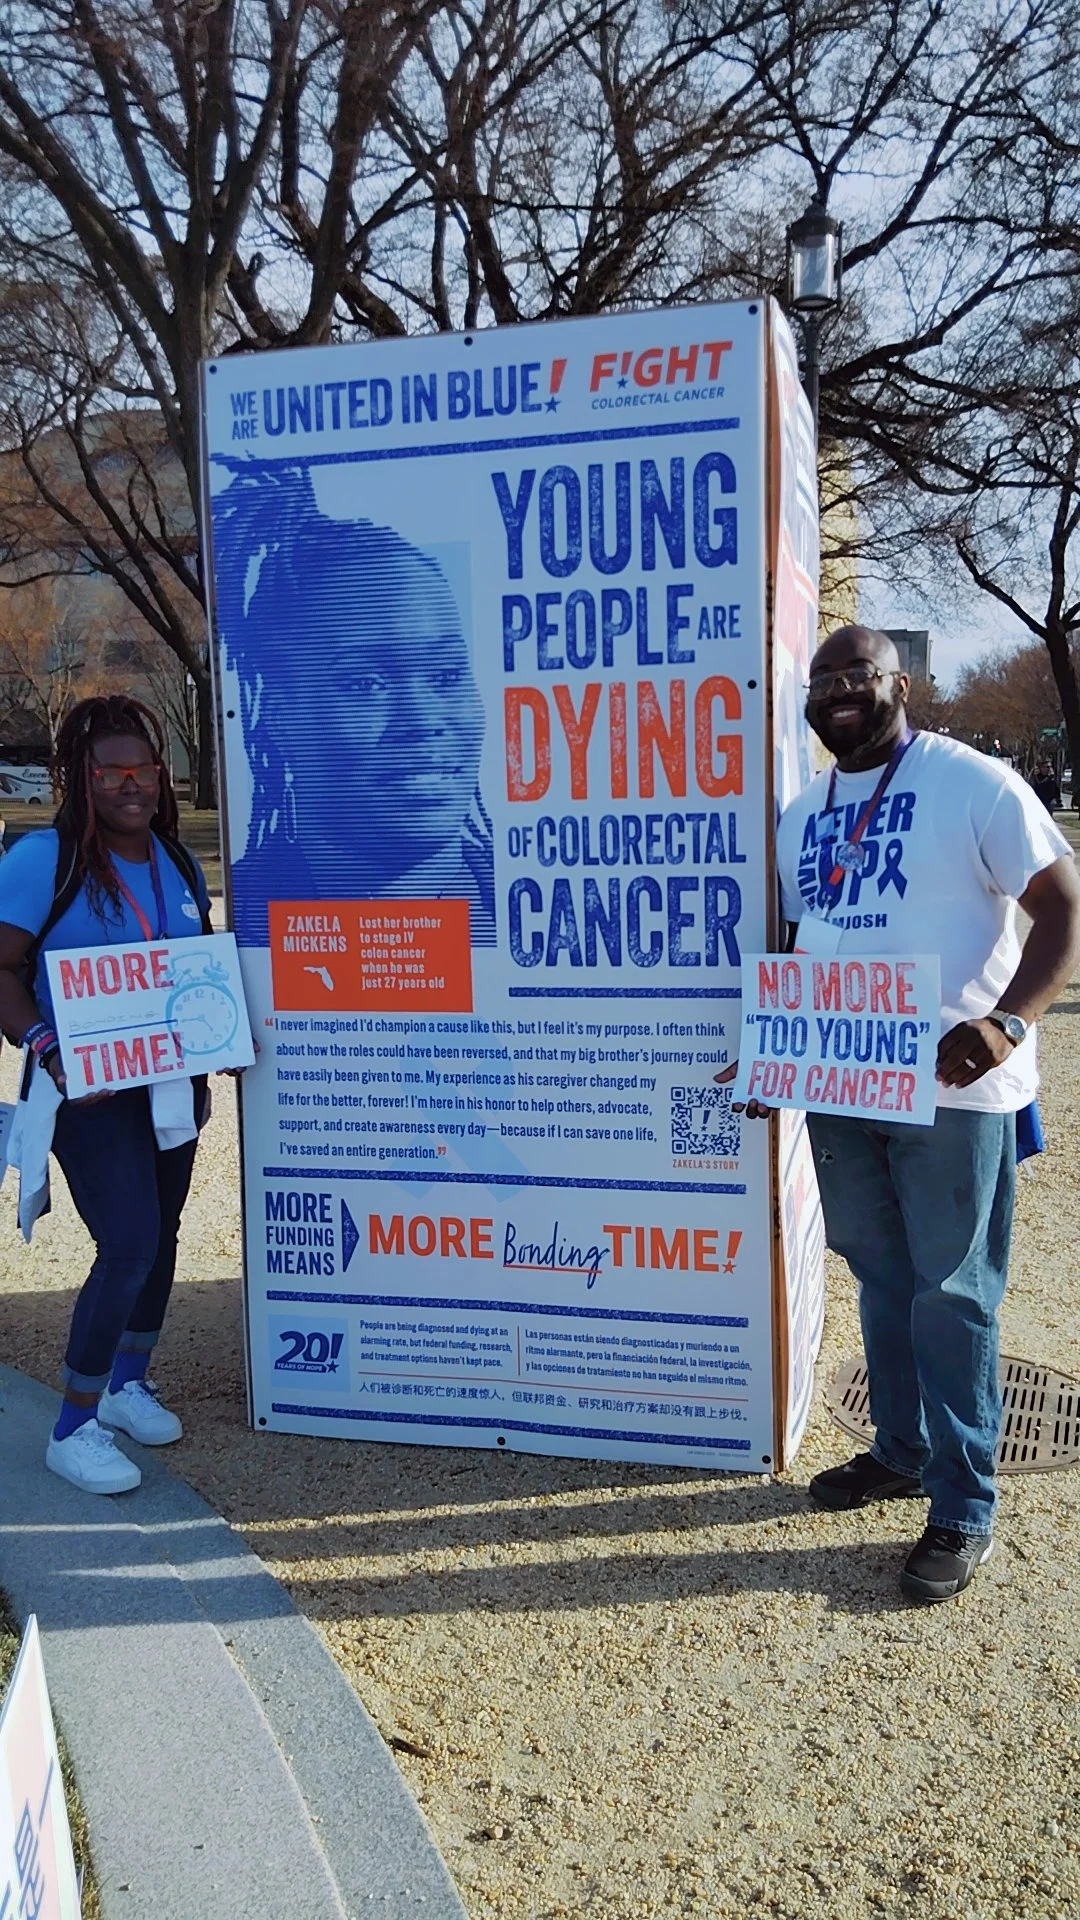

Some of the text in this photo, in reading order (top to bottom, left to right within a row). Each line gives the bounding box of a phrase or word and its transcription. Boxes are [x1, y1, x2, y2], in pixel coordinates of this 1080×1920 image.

[230, 391, 257, 417] WE
[263, 358, 567, 437] UNITED IN BLUE!
[591, 386, 725, 410] COLORECTAL CANCER
[231, 418, 259, 441] ARE
[491, 451, 739, 580] YOUNG
[501, 583, 741, 673] PEOPLE ARE
[504, 675, 744, 803] DYING
[507, 812, 746, 868] OF COLORECTAL
[287, 916, 341, 933] ZAKELA
[359, 916, 441, 929] Lost her brother
[508, 875, 742, 970] CANCER
[283, 935, 348, 953] MICKENS
[359, 931, 414, 946] to stage IV
[360, 946, 426, 959] colon cancer
[59, 949, 175, 1000] MORE
[361, 961, 425, 974] when he was
[362, 975, 445, 991] just 27 years old
[758, 960, 918, 1015] NO MORE
[280, 1020, 309, 1031] never
[310, 1018, 359, 1034] imagined
[374, 1019, 427, 1035] champion
[428, 1022, 435, 1033] a
[436, 1022, 469, 1034] cause
[470, 1019, 490, 1034] like
[491, 1020, 516, 1036] this,
[517, 1020, 536, 1034] but
[537, 1020, 542, 1035] I
[543, 1020, 565, 1035] feel
[585, 1024, 603, 1038] my
[604, 1024, 654, 1038] purpose.
[656, 1021, 660, 1036] I
[662, 1022, 693, 1037] often
[695, 1022, 726, 1037] think
[73, 1031, 185, 1087] TIME!
[276, 1043, 305, 1056] about
[307, 1043, 329, 1057] how
[329, 1043, 347, 1057] the
[348, 1044, 375, 1057] roles
[376, 1044, 406, 1058] could
[406, 1044, 432, 1058] have
[433, 1045, 460, 1059] been
[461, 1046, 512, 1061] reversed,
[513, 1046, 534, 1060] and
[535, 1047, 559, 1061] that
[560, 1050, 577, 1064] my
[578, 1047, 597, 1065] big
[650, 1049, 694, 1066] journey
[696, 1049, 728, 1064] could
[277, 1067, 657, 1092] have easily been given to me. My experience as his caregiver changed my
[747, 1060, 916, 1113] FOR CANCER
[278, 1092, 295, 1106] life
[295, 1092, 311, 1106] for
[312, 1093, 330, 1107] the
[331, 1093, 366, 1108] better,
[367, 1094, 409, 1108] forever!
[429, 1095, 454, 1110] here
[454, 1096, 465, 1110] in
[466, 1096, 483, 1110] his
[484, 1096, 516, 1111] honor
[517, 1099, 529, 1112] to
[530, 1098, 555, 1115] help
[556, 1099, 596, 1115] others,
[597, 1100, 653, 1116] advocate,
[278, 1119, 322, 1133] support,
[323, 1118, 343, 1132] and
[344, 1120, 378, 1133] create
[379, 1122, 436, 1134] awareness
[437, 1123, 466, 1138] every
[547, 1124, 556, 1138] if
[557, 1124, 561, 1138] I
[563, 1127, 584, 1139] can
[585, 1128, 611, 1140] save
[612, 1129, 634, 1141] one
[635, 1127, 657, 1143] life,
[299, 1143, 330, 1156] saved
[331, 1146, 344, 1157] an
[346, 1144, 377, 1157] entire
[712, 1159, 740, 1171] STORY
[264, 1190, 333, 1224] MORE
[265, 1225, 335, 1248] FUNDING
[367, 1212, 495, 1260] MORE
[502, 1221, 610, 1289] Bonding
[603, 1224, 744, 1276] TIME!
[266, 1250, 335, 1277] MEANS
[359, 1319, 509, 1337] People are being diagnosed and dying at an
[525, 1328, 740, 1353] Las personas están siendo diagnosticadas y muriendo a un
